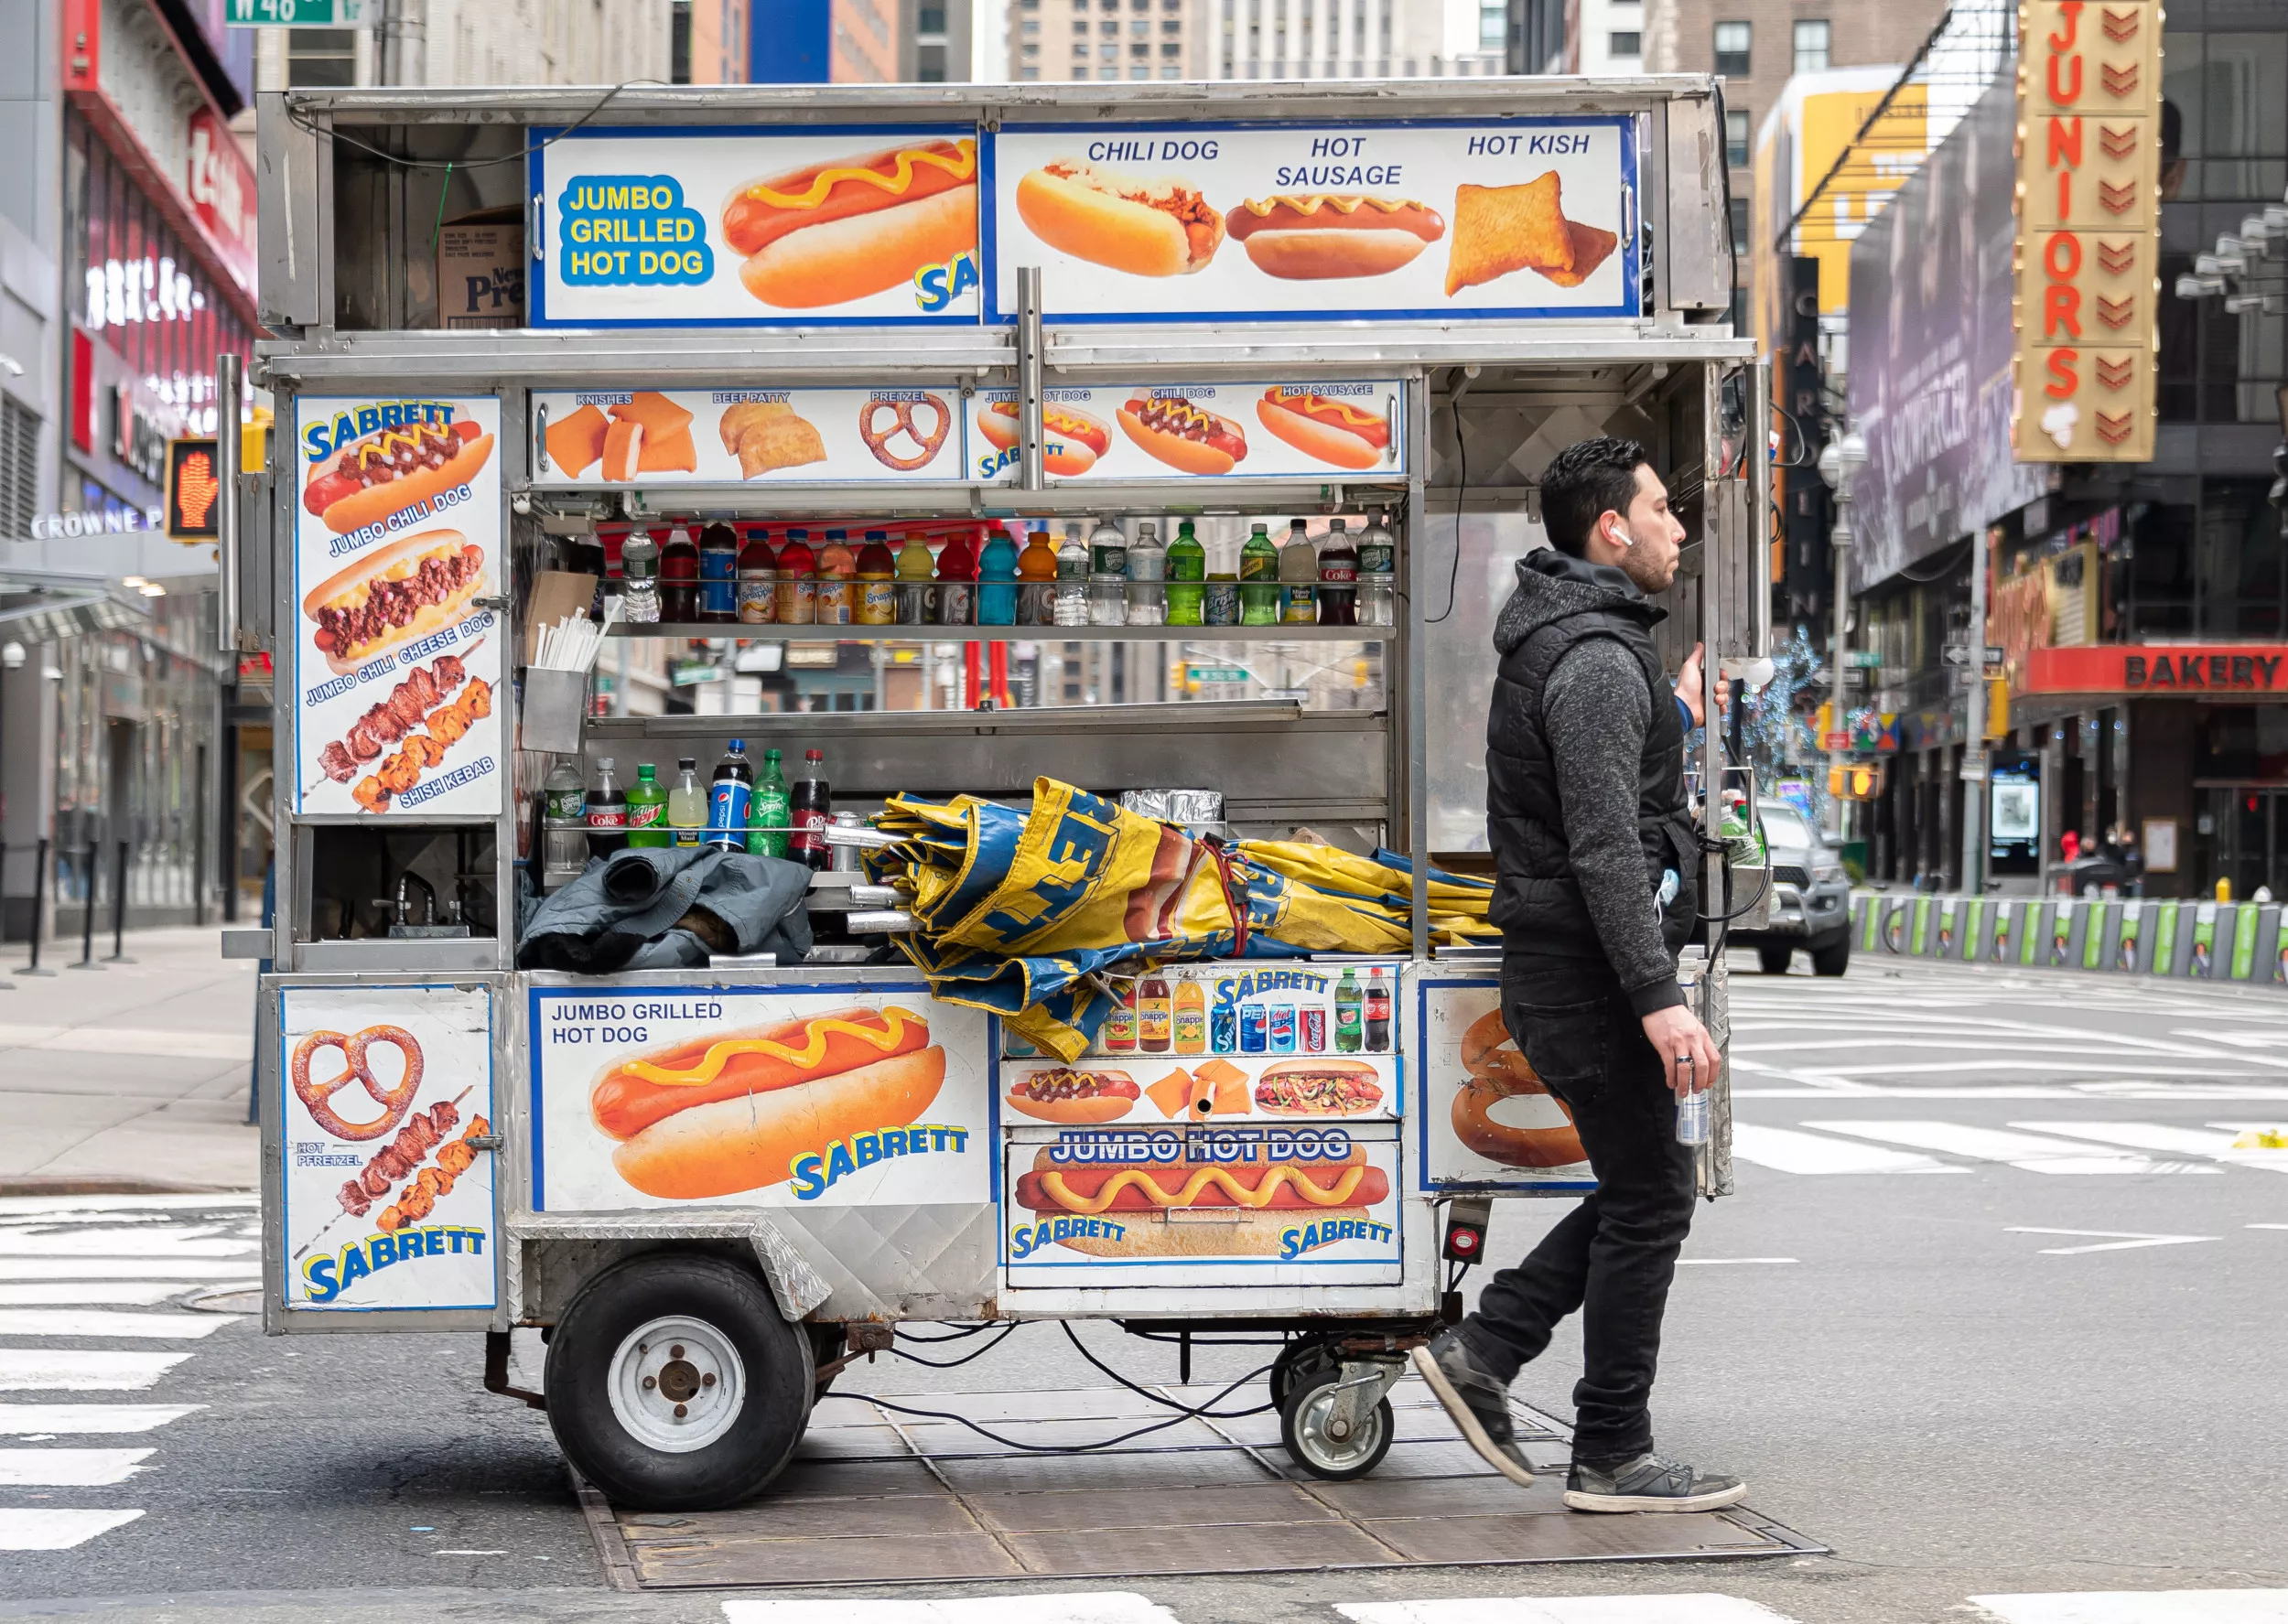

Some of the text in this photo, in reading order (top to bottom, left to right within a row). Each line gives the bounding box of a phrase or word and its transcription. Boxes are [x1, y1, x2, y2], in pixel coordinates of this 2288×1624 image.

[1088, 141, 1219, 162] CHILI DOG
[1311, 137, 1365, 158] HOT
[1467, 134, 1591, 156] HOT KISH
[1276, 165, 1402, 187] SAUSAGE
[569, 186, 674, 211] JUMBO
[2044, 0, 2084, 399] JUNIORS
[569, 218, 696, 243] GRILLED
[570, 251, 704, 275] HOT DOG
[576, 393, 633, 405] KNISHES
[712, 392, 791, 404] BEEF PATTY
[870, 391, 929, 403] PRETZEL
[985, 390, 1091, 403] JUMB OT DOG
[1150, 387, 1216, 400] CHILI DOG
[1281, 384, 1374, 397] HOT SAUSAGE
[301, 400, 455, 463] SABRETT
[977, 442, 1064, 479] SABTT
[31, 507, 140, 540] CROWNE
[329, 483, 472, 557] JUMBO CHILI DOG
[1325, 569, 1352, 581] Coke
[741, 586, 773, 602] Snapple
[306, 611, 495, 707] JUMBO CHILI CHEESE DOG
[2125, 654, 2283, 686] BAKERY
[399, 756, 495, 809] SHISH KEBAB
[718, 804, 726, 828] pepsi
[759, 801, 783, 812] Sprite
[590, 814, 619, 826] Coke
[1213, 967, 1329, 1008] SABRETT
[551, 1002, 722, 1021] JUMBO GRILLED
[1140, 1011, 1169, 1022] Snapple
[1176, 1016, 1203, 1026] Snapple
[553, 1026, 648, 1044] HOT DOG
[297, 1142, 325, 1154] HOT
[1050, 1128, 1352, 1164] JUMBO HOT DOG
[297, 1155, 363, 1167] PFRETZEL
[788, 1124, 969, 1200] SABRETT
[1010, 1215, 1126, 1260] SABRETT
[1277, 1216, 1393, 1260] SABRETT
[301, 1224, 486, 1303] SABRETT
